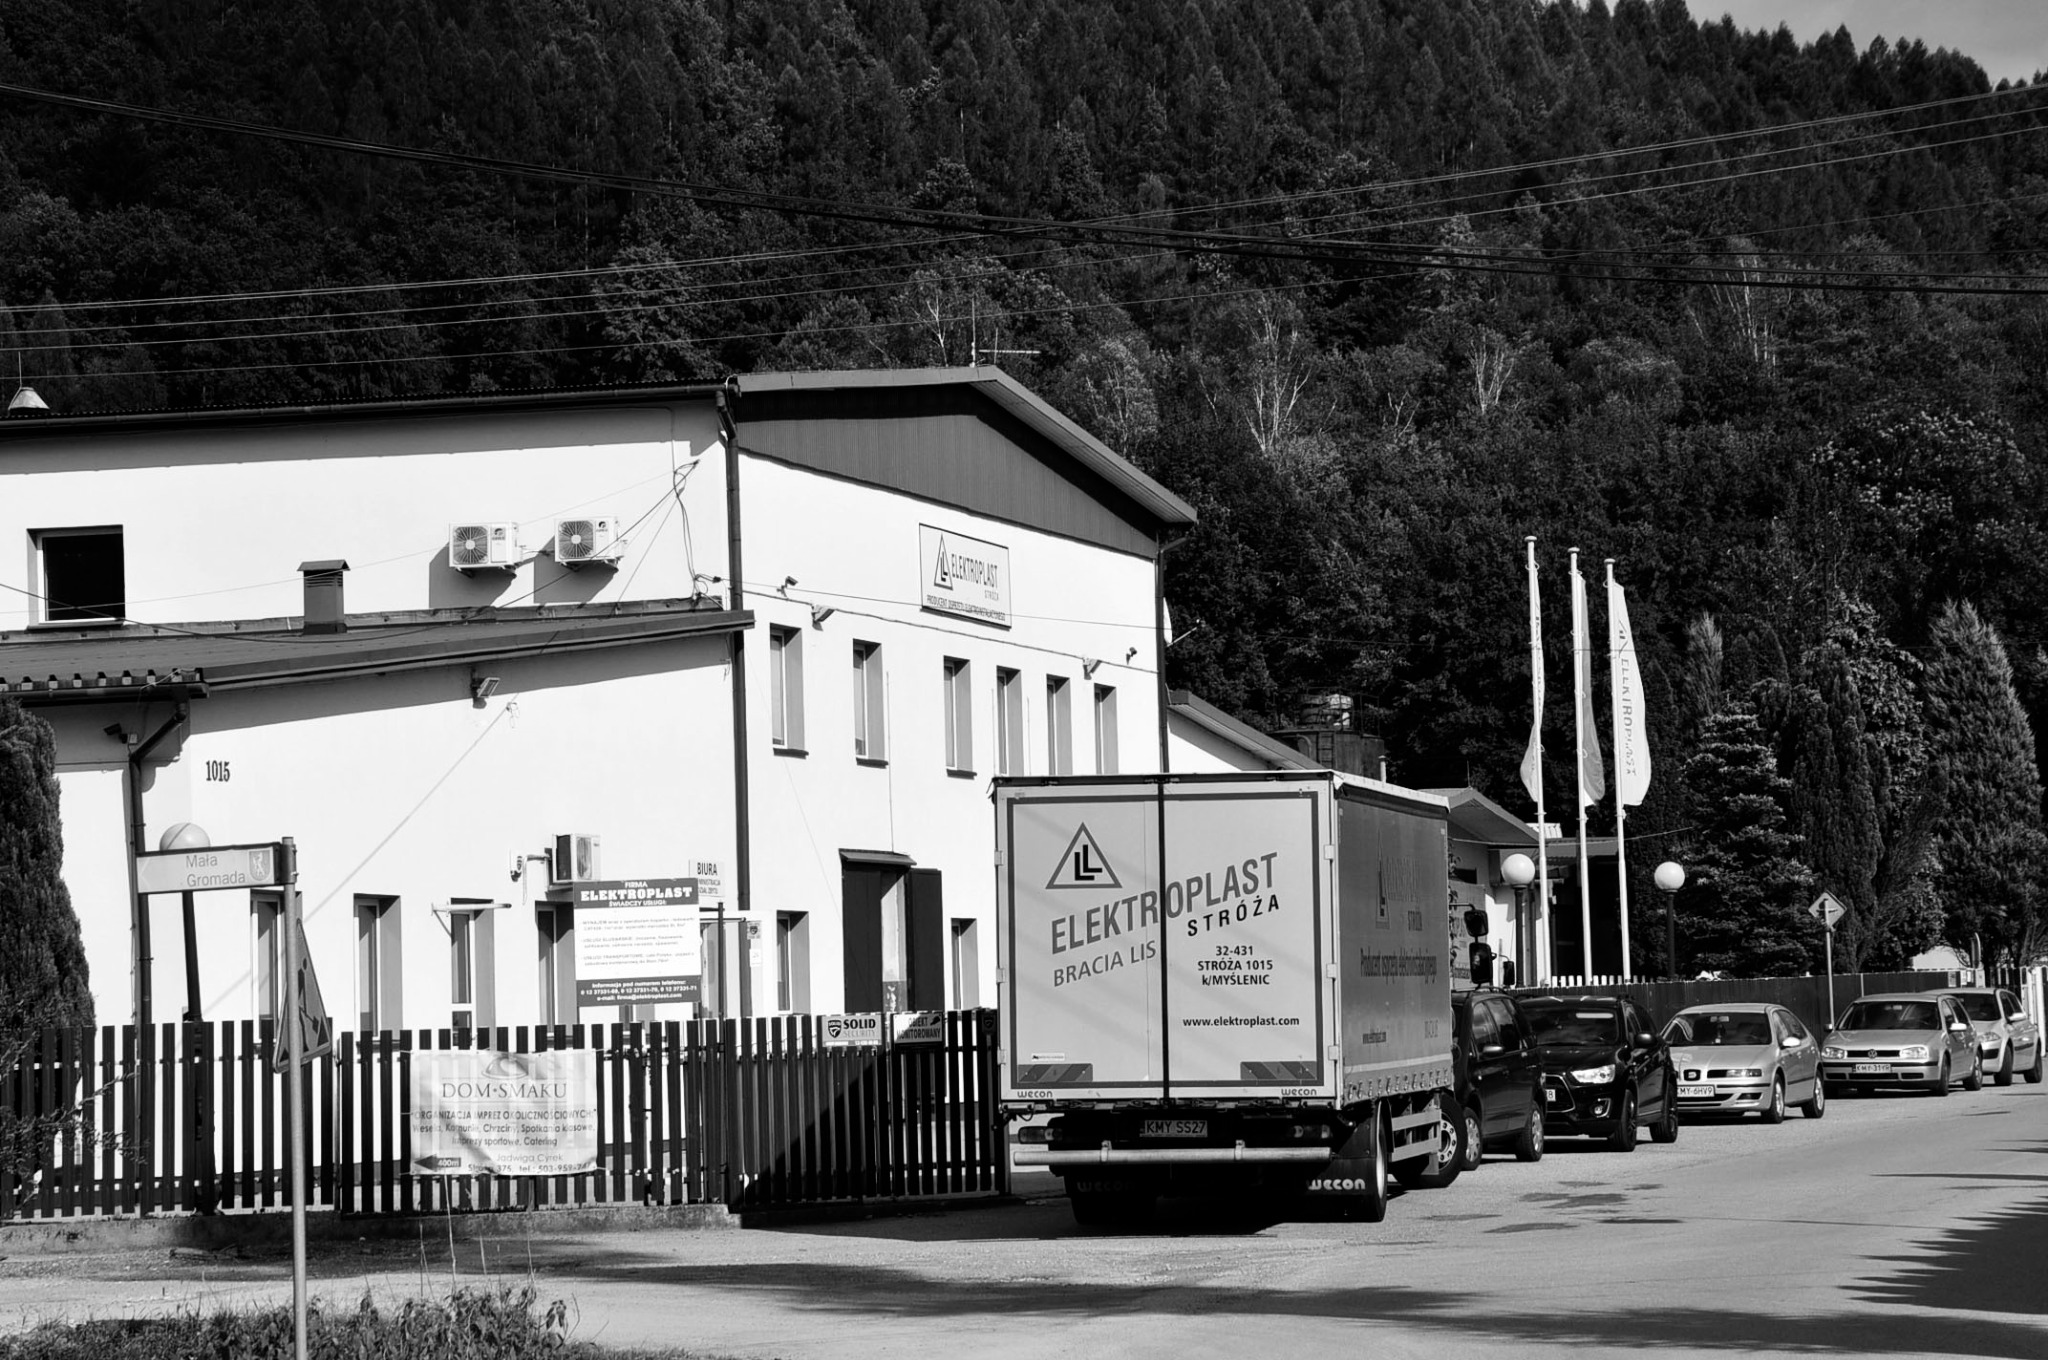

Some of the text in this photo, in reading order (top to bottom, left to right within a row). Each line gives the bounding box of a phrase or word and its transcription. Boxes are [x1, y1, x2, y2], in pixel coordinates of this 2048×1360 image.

[205, 760, 230, 782] 1015
[185, 854, 218, 868] Mała
[697, 862, 718, 876] BIURA
[186, 871, 246, 887] Gromada
[624, 881, 648, 889] FIRMA
[580, 886, 693, 901] ELEKTROPLAST
[1051, 852, 1278, 955] ELEKTROPLAST
[1187, 894, 1280, 937] STRÓŻA
[1215, 945, 1254, 956] 32-431
[1053, 940, 1157, 987] BRACIA LIS
[1197, 957, 1273, 971] STRÓŻA 1015
[1202, 972, 1270, 986] k/MYŚLENIC
[843, 1018, 876, 1029] SOLID
[1182, 1016, 1300, 1028] www.elektroplast.com
[843, 1030, 876, 1038] SECURITY
[1017, 1090, 1053, 1099] wecon
[1281, 1088, 1317, 1096] wecon
[1146, 1121, 1206, 1134] KMY SS27
[523, 1136, 558, 1147] Catering
[437, 1158, 460, 1168] 400m
[497, 1153, 535, 1164] Jadwiga
[1306, 1178, 1366, 1190] wecon
